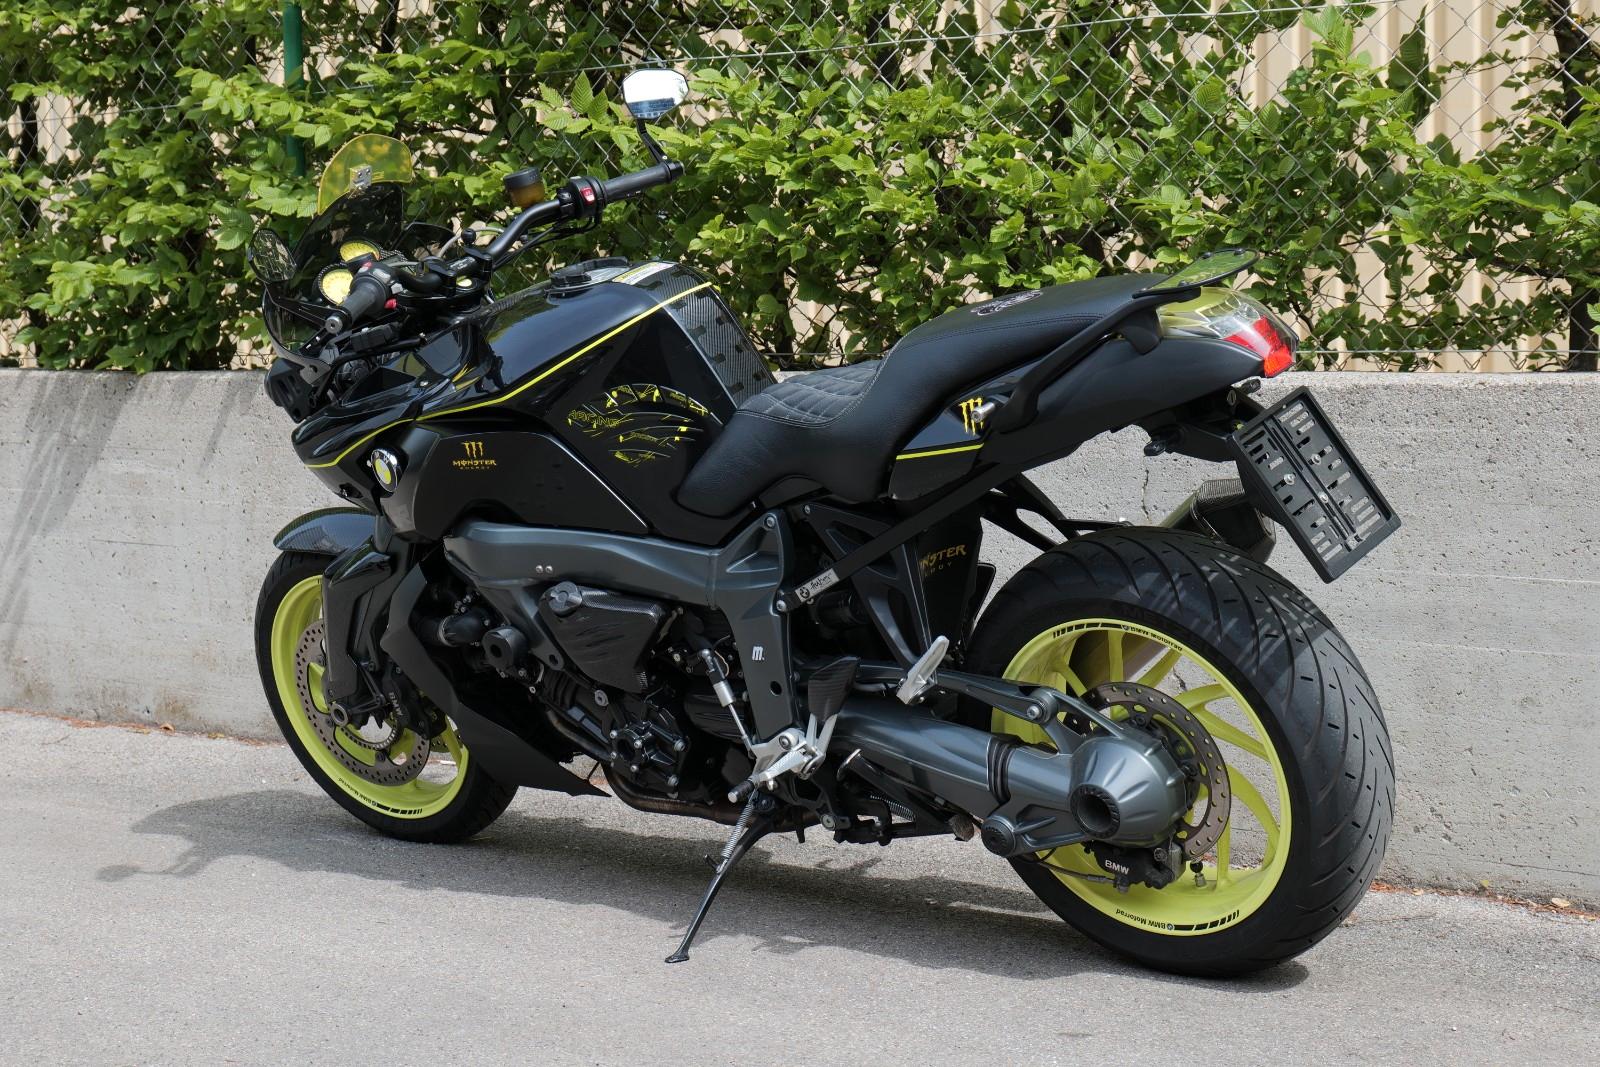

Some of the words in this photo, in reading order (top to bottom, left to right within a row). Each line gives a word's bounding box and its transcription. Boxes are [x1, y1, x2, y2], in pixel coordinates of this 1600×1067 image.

[452, 459, 497, 467] MONSTER
[1105, 859, 1130, 875] BMW
[1116, 908, 1147, 925] Motorrad
[1149, 920, 1166, 930] BMW
